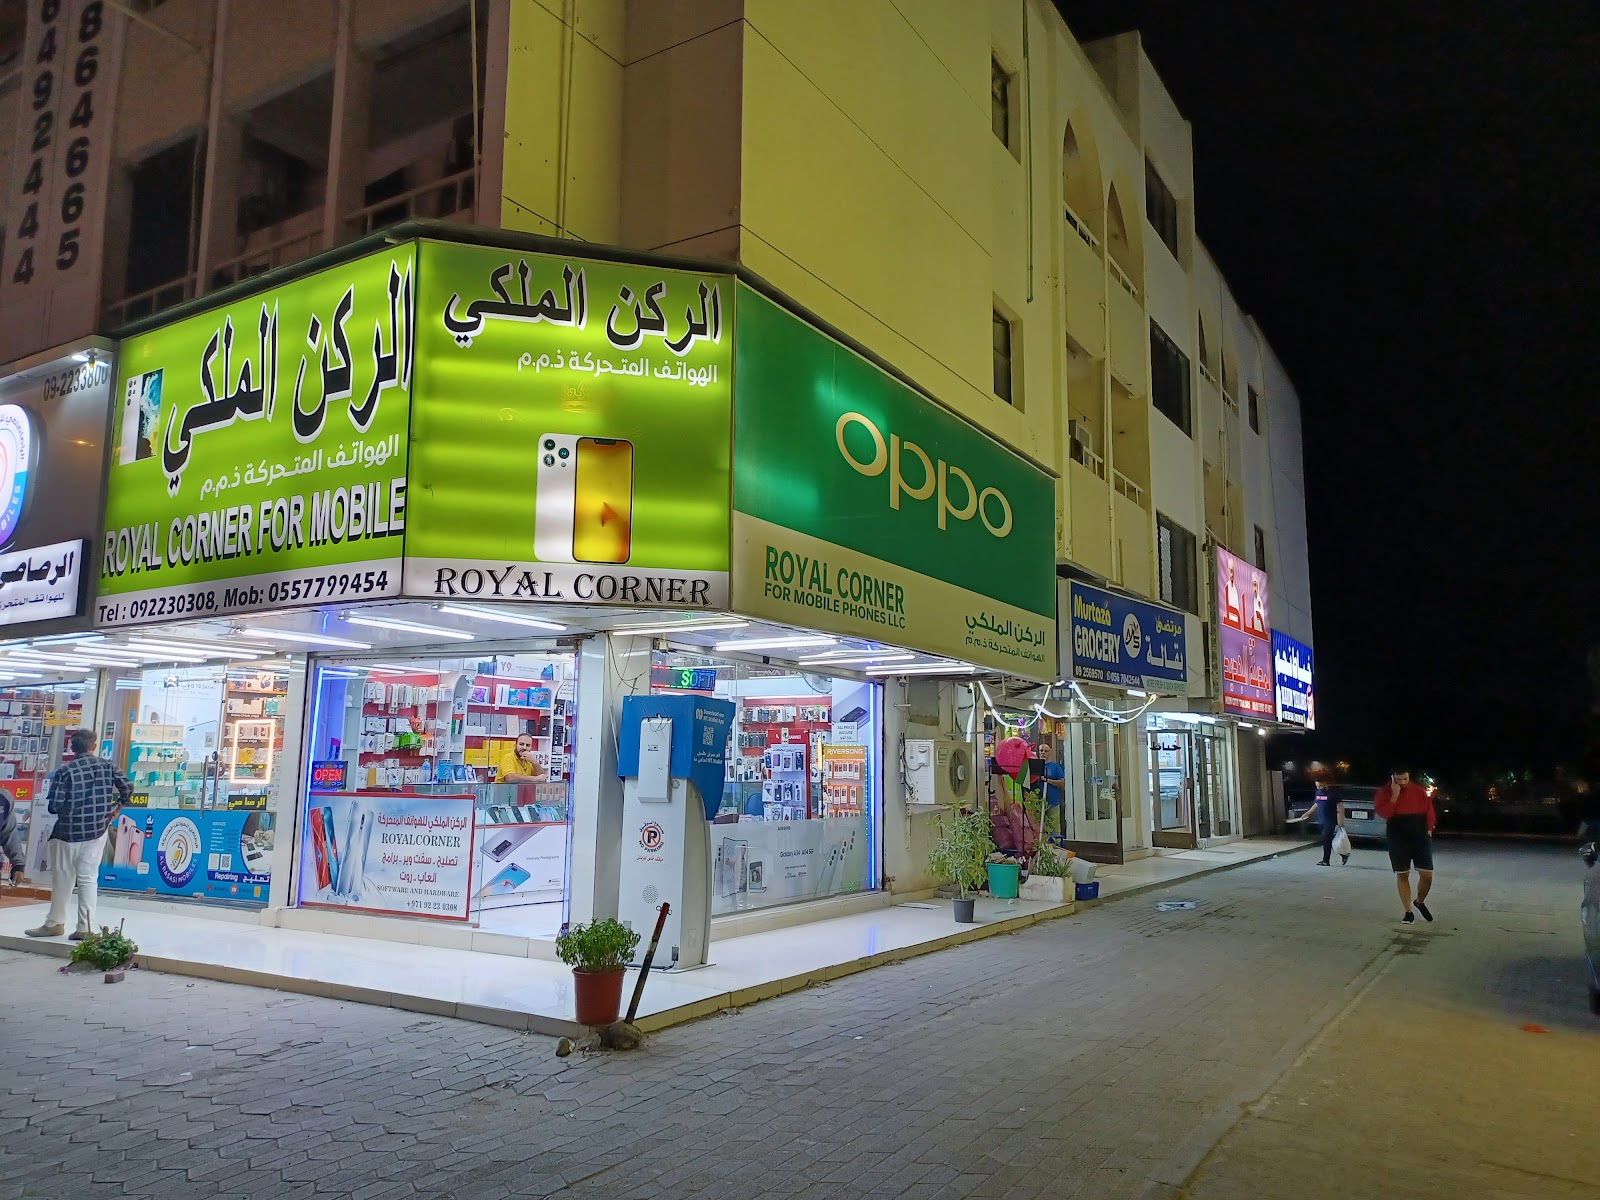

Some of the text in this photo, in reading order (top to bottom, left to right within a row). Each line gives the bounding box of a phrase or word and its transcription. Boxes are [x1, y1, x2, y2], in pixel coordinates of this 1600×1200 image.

[443, 259, 722, 357] الركن الملكي
[162, 254, 413, 498] الركن الملكي
[569, 351, 650, 377] المتحركة
[654, 361, 718, 388] الهواتف
[327, 434, 399, 468] الهواتف
[244, 449, 323, 488] المتحركة
[102, 477, 407, 577] ROYAL CORNER FOR MOBILE
[434, 565, 711, 607] ROYAL CORNER
[765, 546, 905, 614] ROYAL CORNER
[130, 592, 218, 618] 092230308,
[224, 587, 263, 608] Mob:
[269, 571, 388, 602] 0557799454
[764, 582, 906, 629] FOR MOBILE PHONES LLC
[1074, 594, 1112, 626] Murtaza
[965, 612, 1045, 647] الركن الملكي
[989, 639, 1019, 657] المتحركة
[1074, 625, 1120, 664] GROCERY
[1145, 635, 1183, 680] بقالة
[1075, 666, 1082, 676] 09
[1149, 741, 1181, 751] خياط
[315, 769, 343, 781] OPEN
[377, 812, 467, 832] الركن الملكي للهواتف المتحركة
[381, 833, 460, 847] ROYALCORNER
[644, 842, 664, 852] PARKING
[162, 866, 178, 883] RASASI
[437, 856, 458, 867] تصليح
[214, 872, 238, 882] Repairing
[377, 885, 459, 898] SOFTWARE AND HARDWARE
[407, 900, 457, 911] +971 92 23 0308
